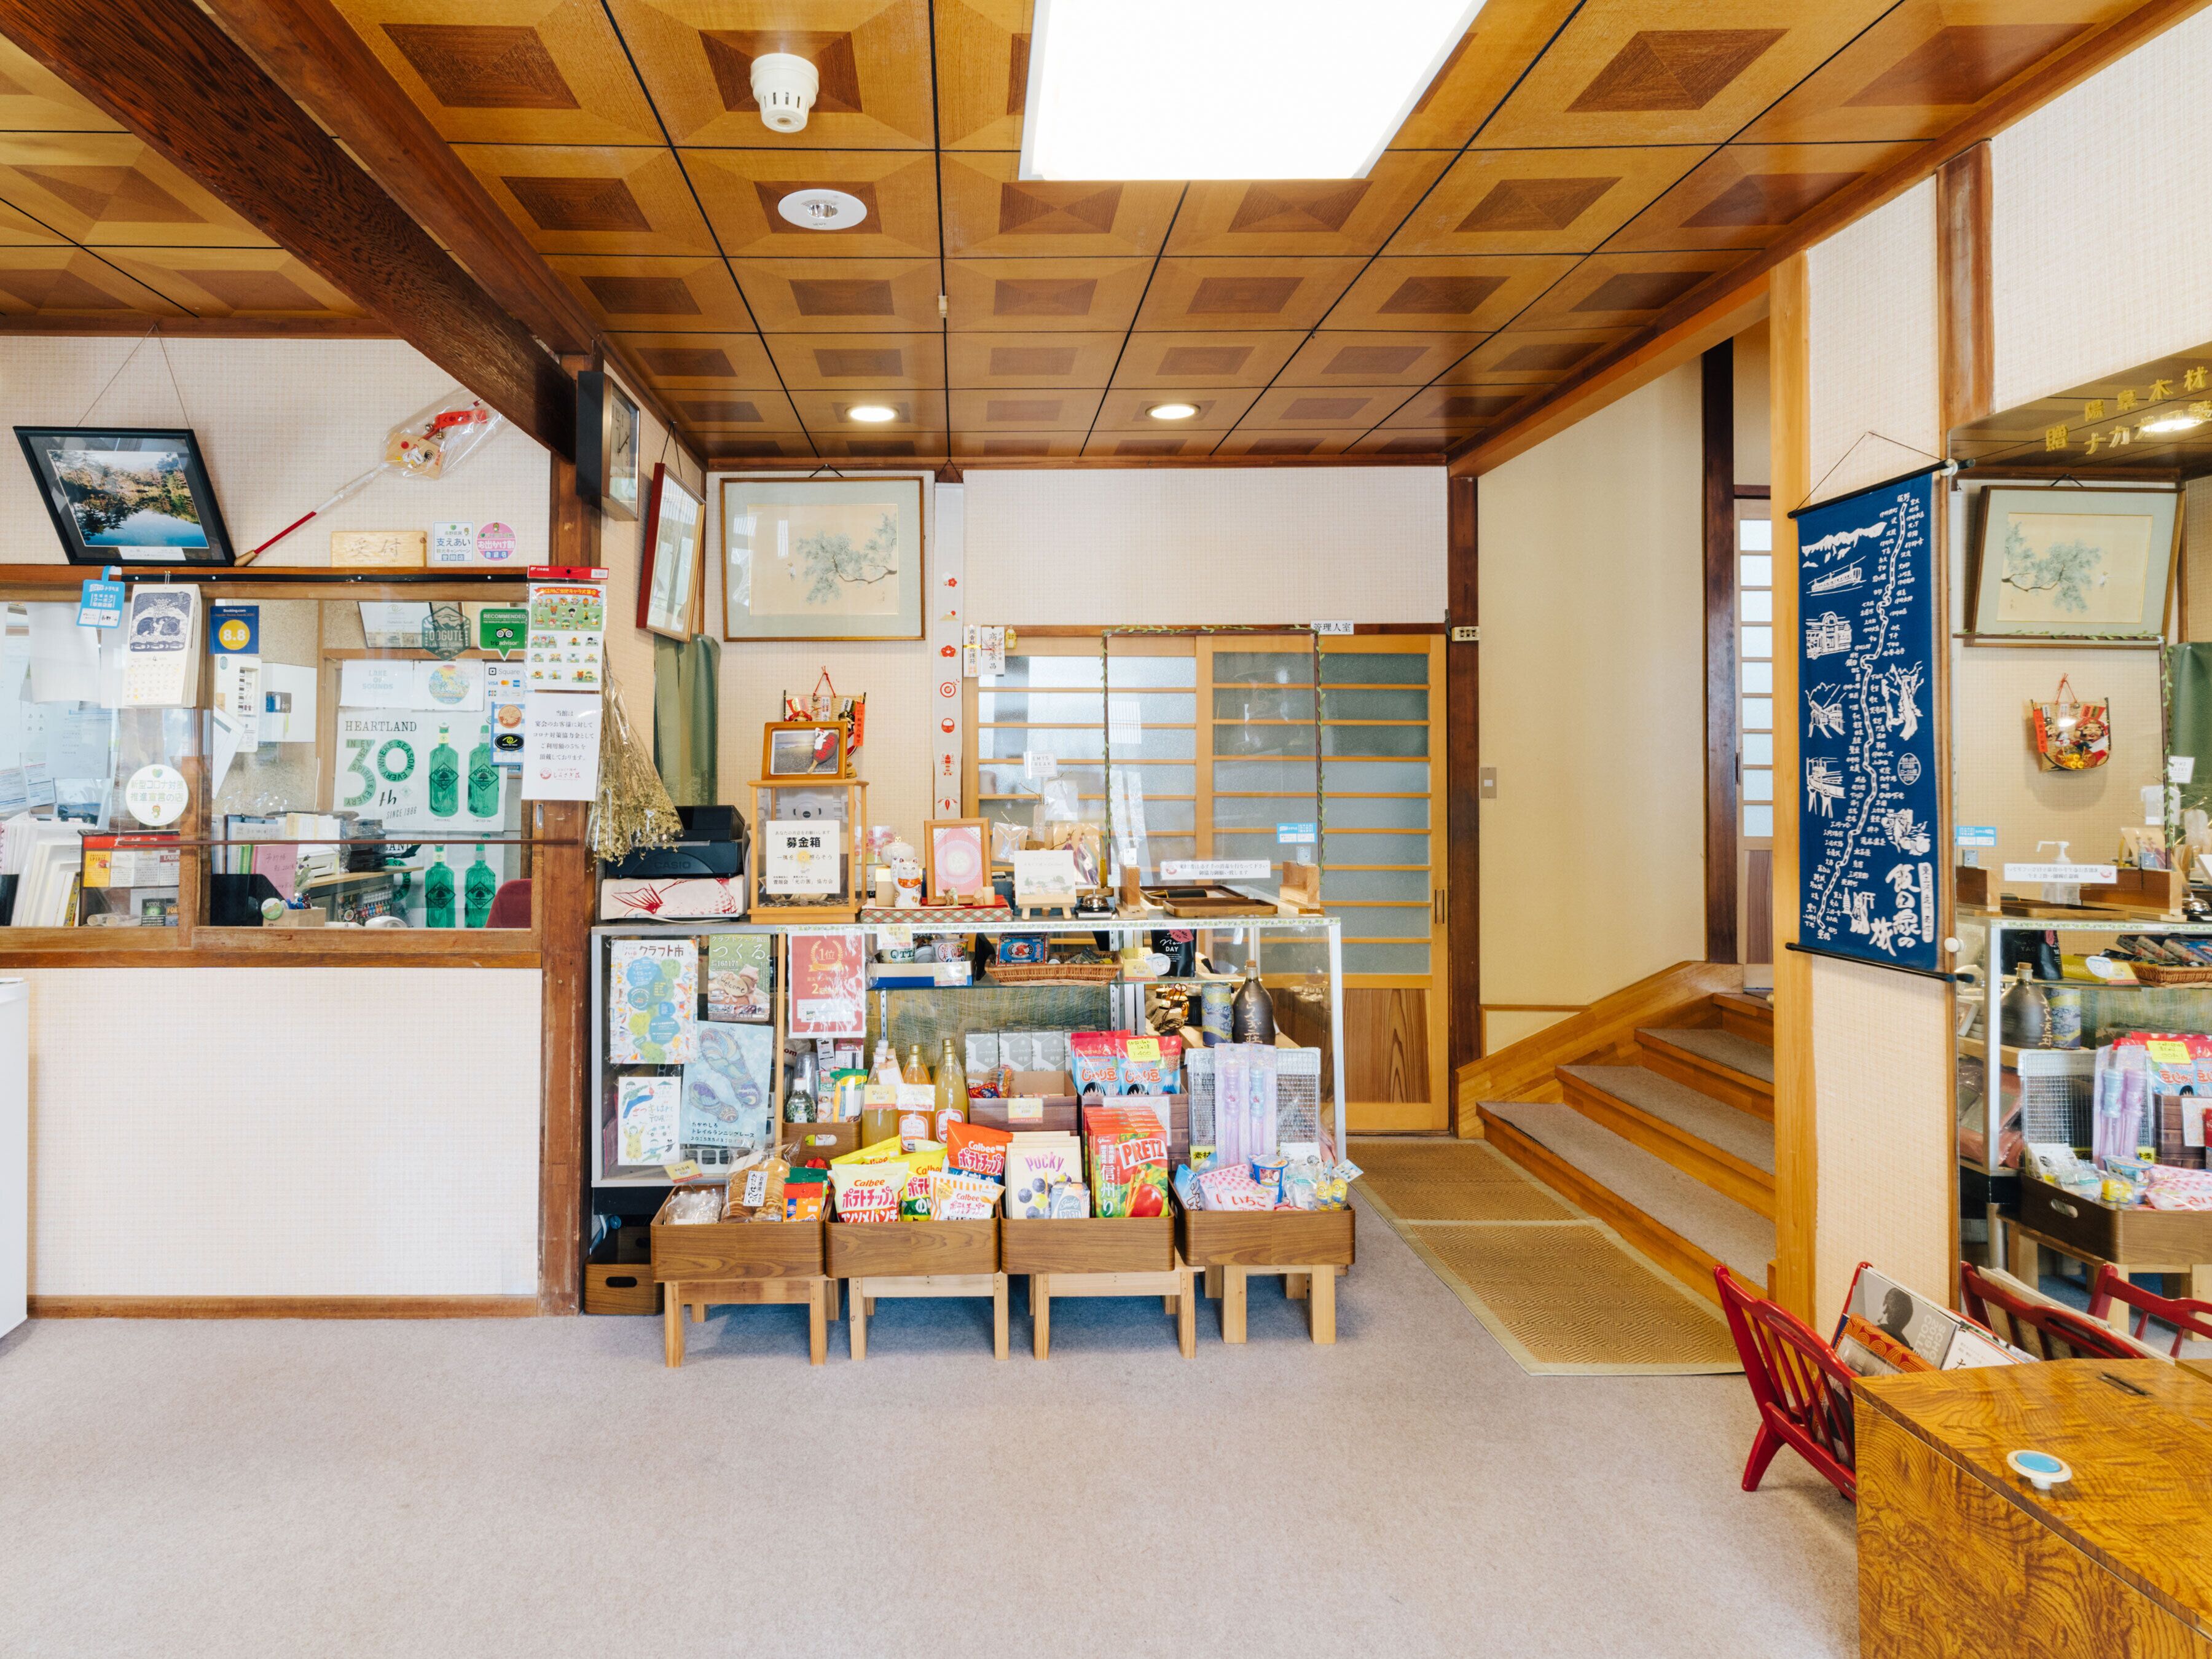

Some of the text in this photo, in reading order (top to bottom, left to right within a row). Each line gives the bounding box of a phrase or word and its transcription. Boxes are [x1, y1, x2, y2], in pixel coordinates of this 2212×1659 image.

[436, 537, 471, 547] 支えあい
[477, 540, 516, 549] お出かけ割
[1314, 622, 1351, 632] 管理人室
[223, 629, 246, 641] 8.8
[345, 721, 417, 732] HEARTLAND
[130, 791, 184, 802] 推進宣言の店
[386, 808, 402, 820] SINCE
[786, 836, 821, 848] 募金箱
[639, 944, 684, 957] クラフト市
[712, 943, 773, 962] つくる。
[818, 948, 835, 961] 1位
[720, 976, 745, 994] Welcome
[1081, 1067, 1118, 1082] じゃり豆
[1124, 1068, 1161, 1084] じゃり豆
[691, 1128, 755, 1139] トレイルランニングレース
[968, 1140, 995, 1153] Calbee
[1121, 1139, 1165, 1167] PRETZ
[842, 1185, 896, 1209] ポテトチップス
[956, 1193, 980, 1202] Calbee
[1231, 1195, 1266, 1207] いちご
